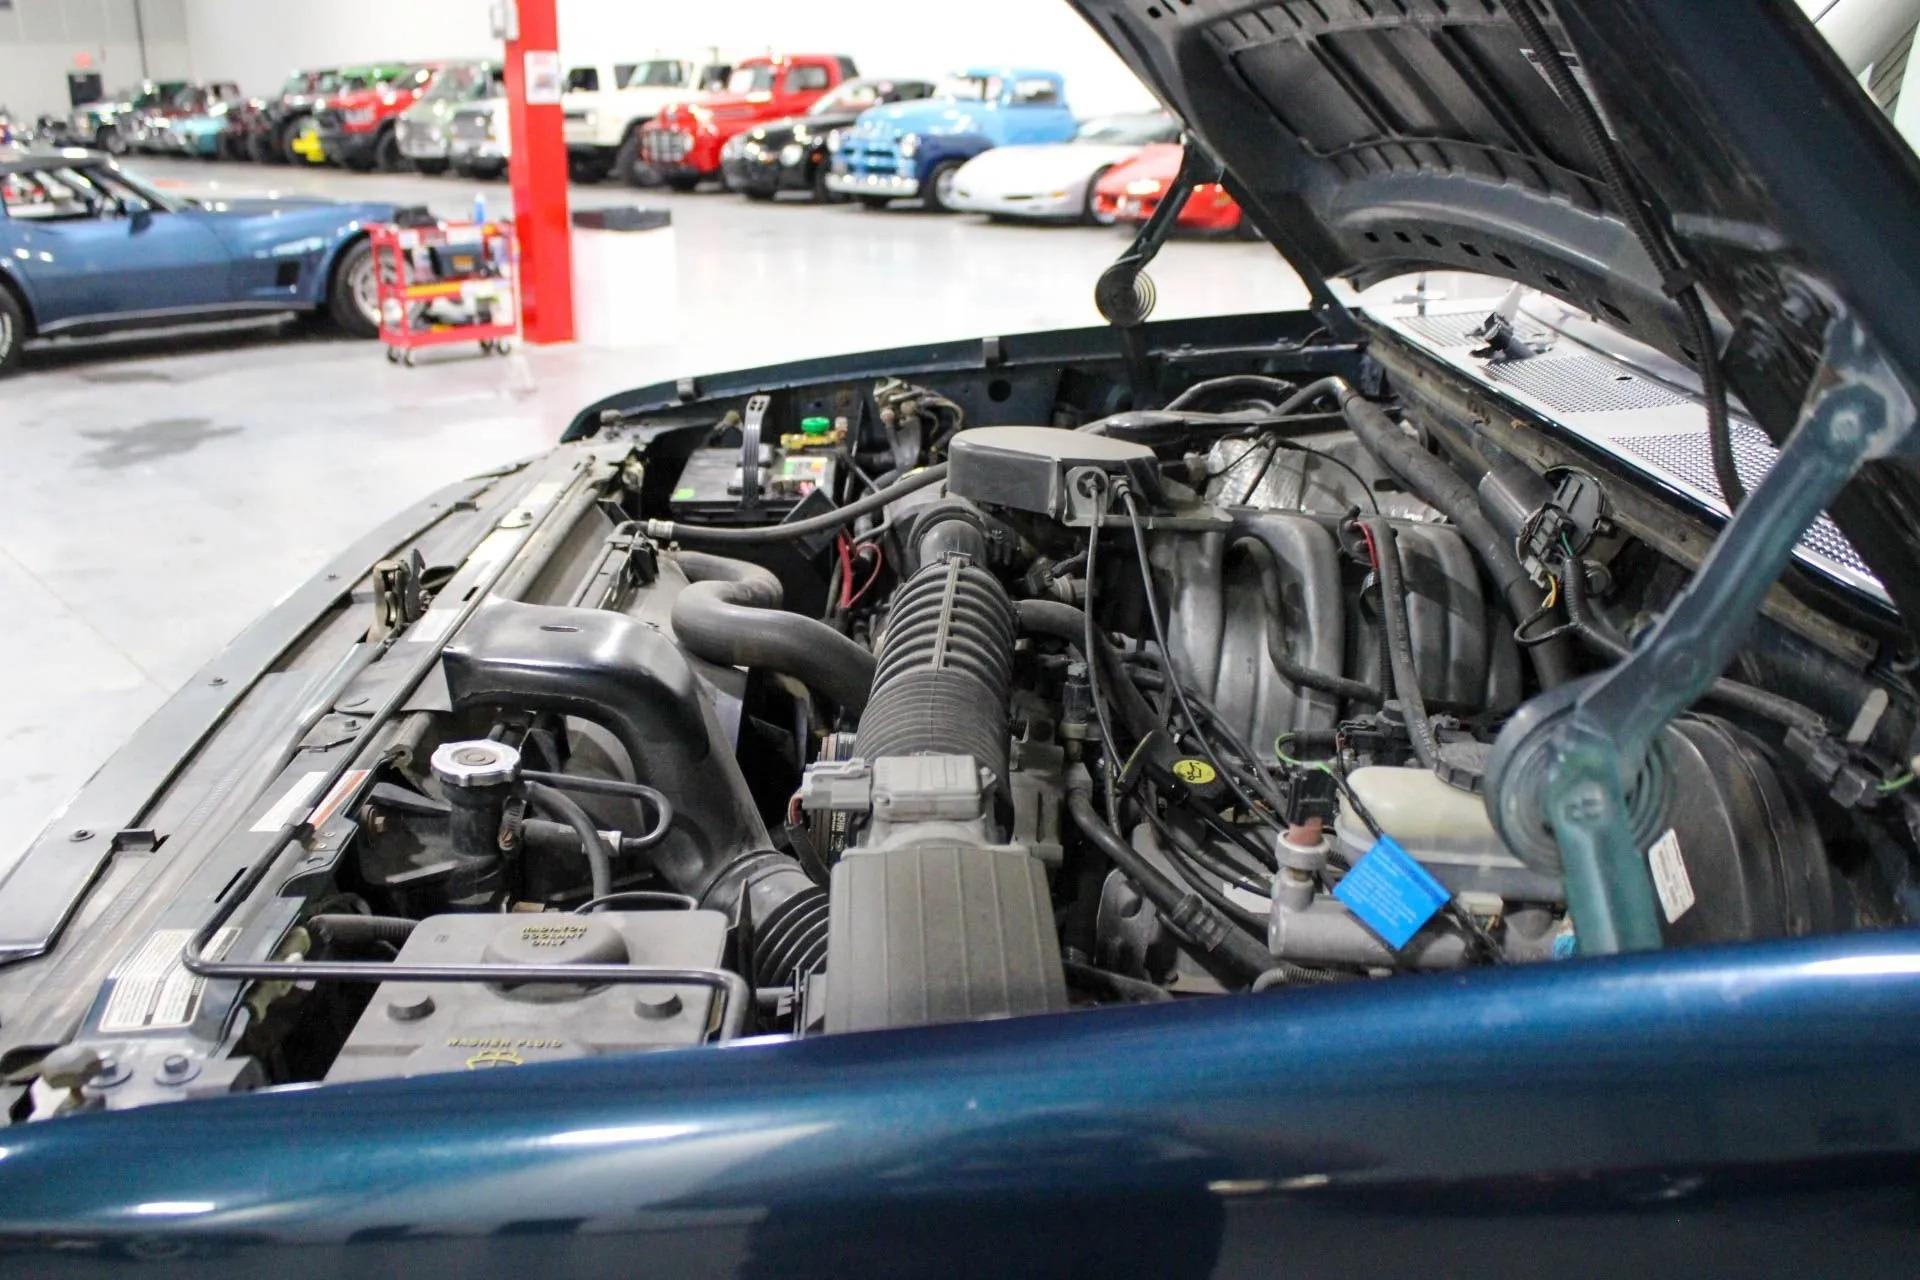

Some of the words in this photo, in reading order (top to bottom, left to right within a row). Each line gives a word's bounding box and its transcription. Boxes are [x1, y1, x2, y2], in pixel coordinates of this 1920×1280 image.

[522, 925, 588, 934] RADIATOR
[521, 932, 584, 940] COOLANT
[446, 1038, 512, 1049] WASHER
[517, 1039, 563, 1049] FLUID
